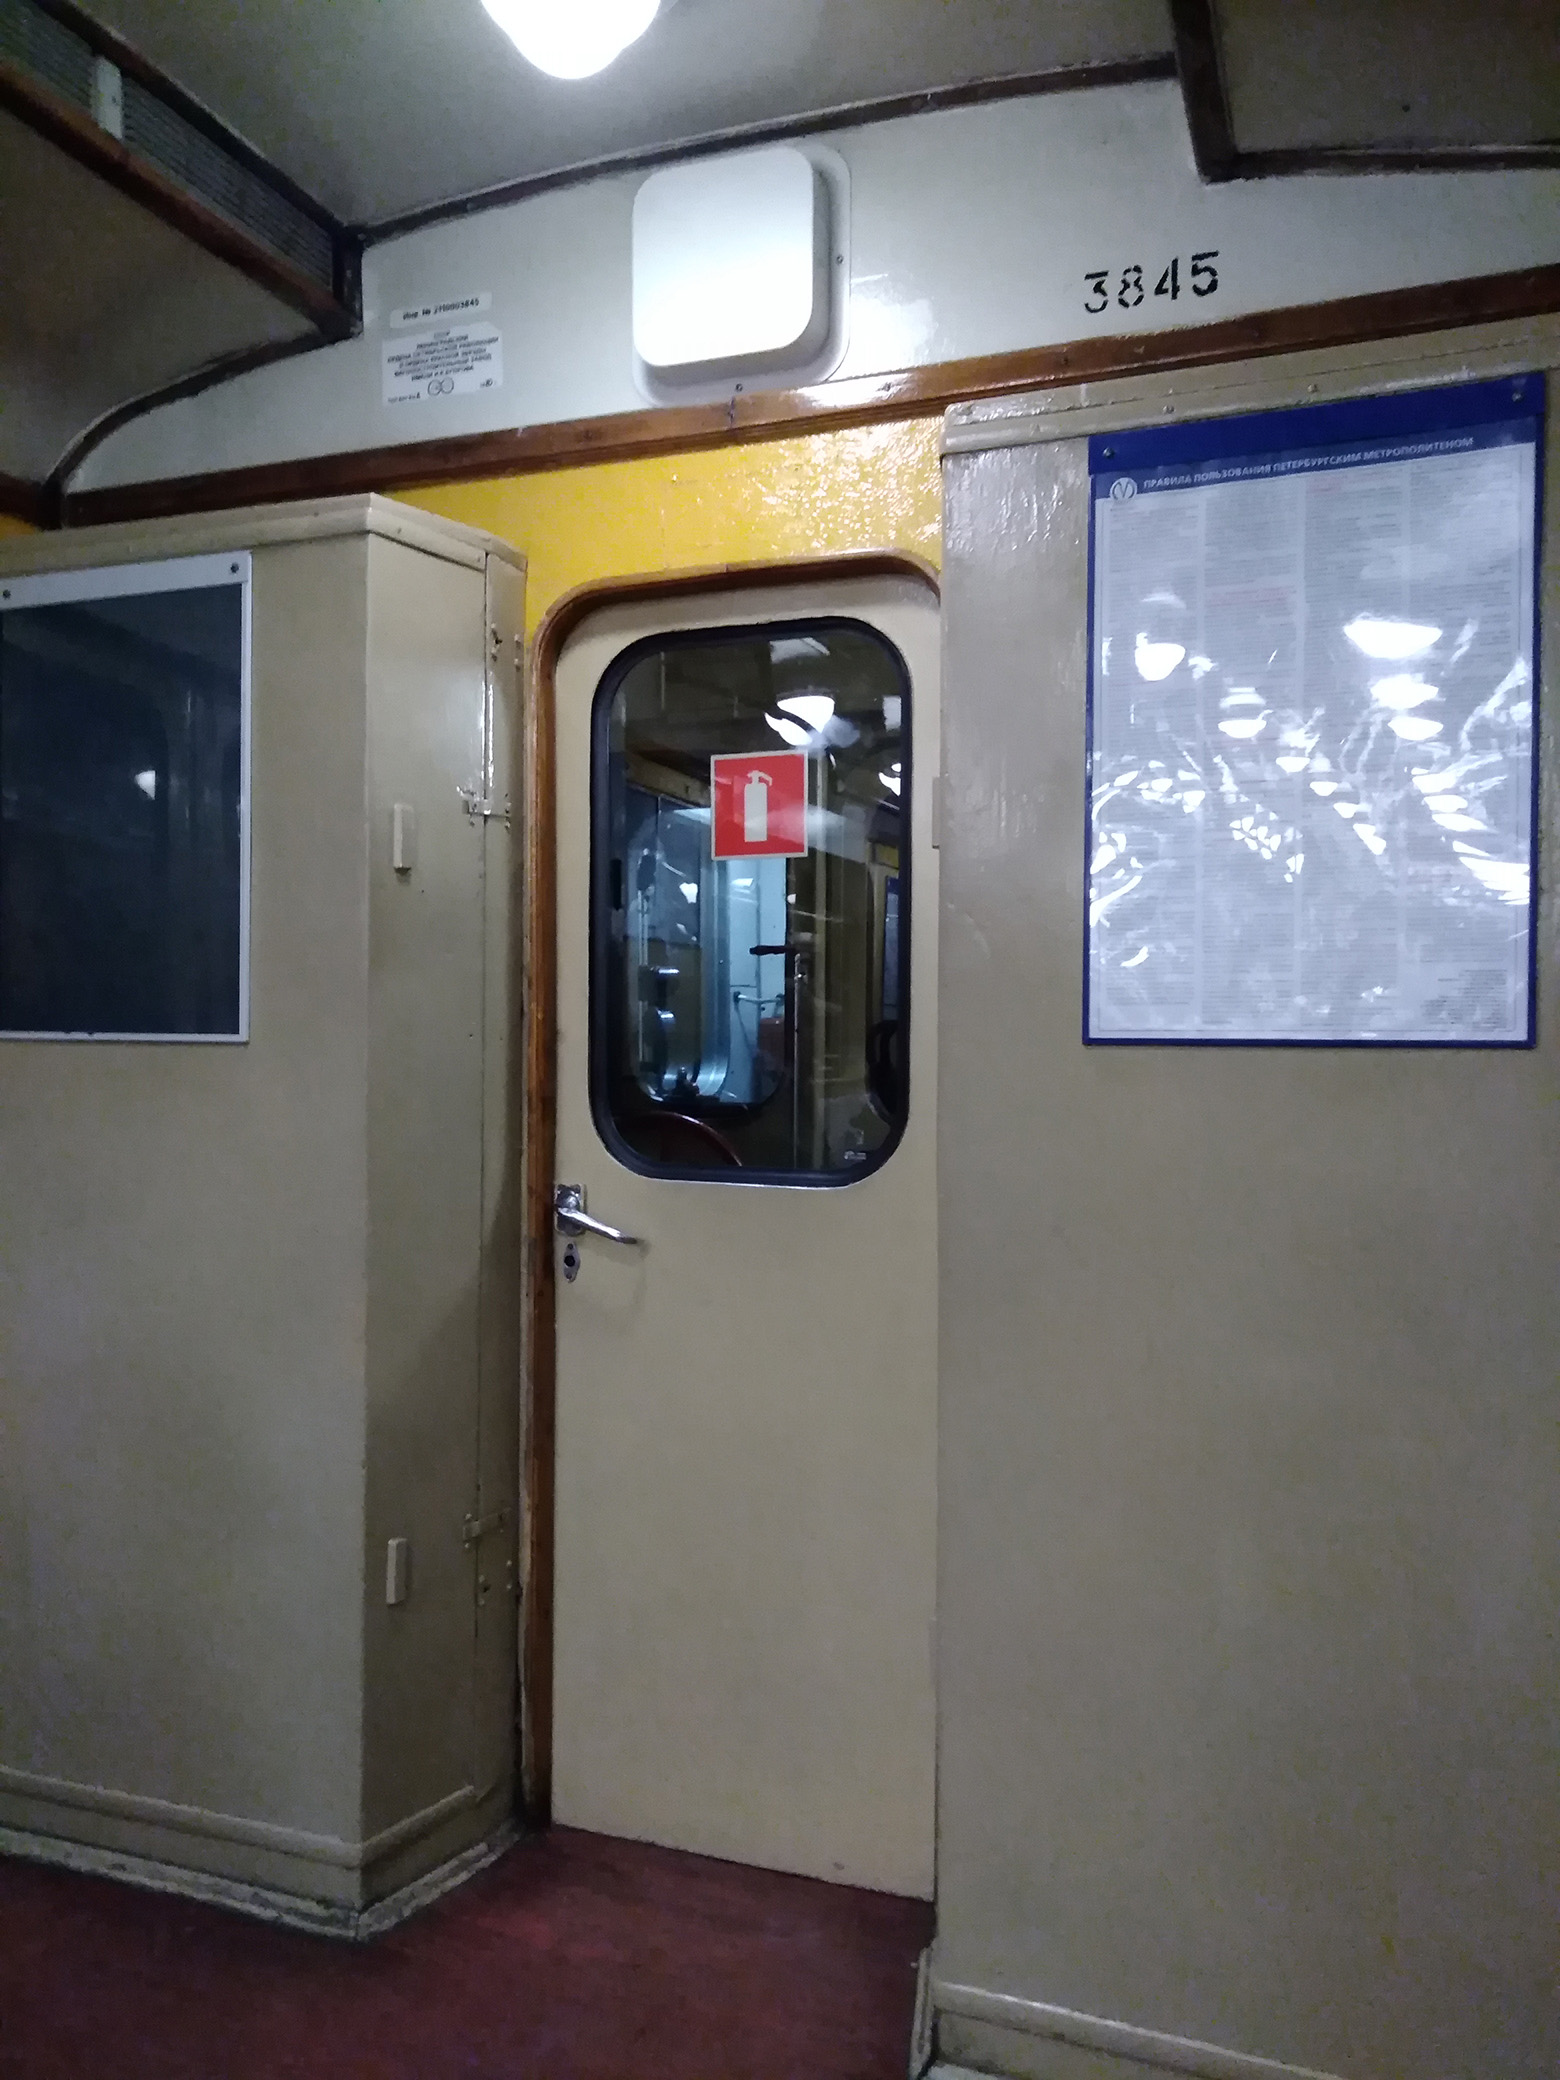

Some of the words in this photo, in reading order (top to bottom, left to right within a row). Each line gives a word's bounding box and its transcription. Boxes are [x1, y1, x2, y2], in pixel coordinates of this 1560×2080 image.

[1084, 249, 1220, 313] 3845
[1143, 474, 1192, 489] ПРАВИЛА
[1194, 465, 1271, 483] ПОЛЬЗОВАНИЯ
[1272, 454, 1363, 472] ПЕТЕРБУРГСКИМ
[1364, 436, 1474, 460] МЕТРОПОЛИТЕНОМ
